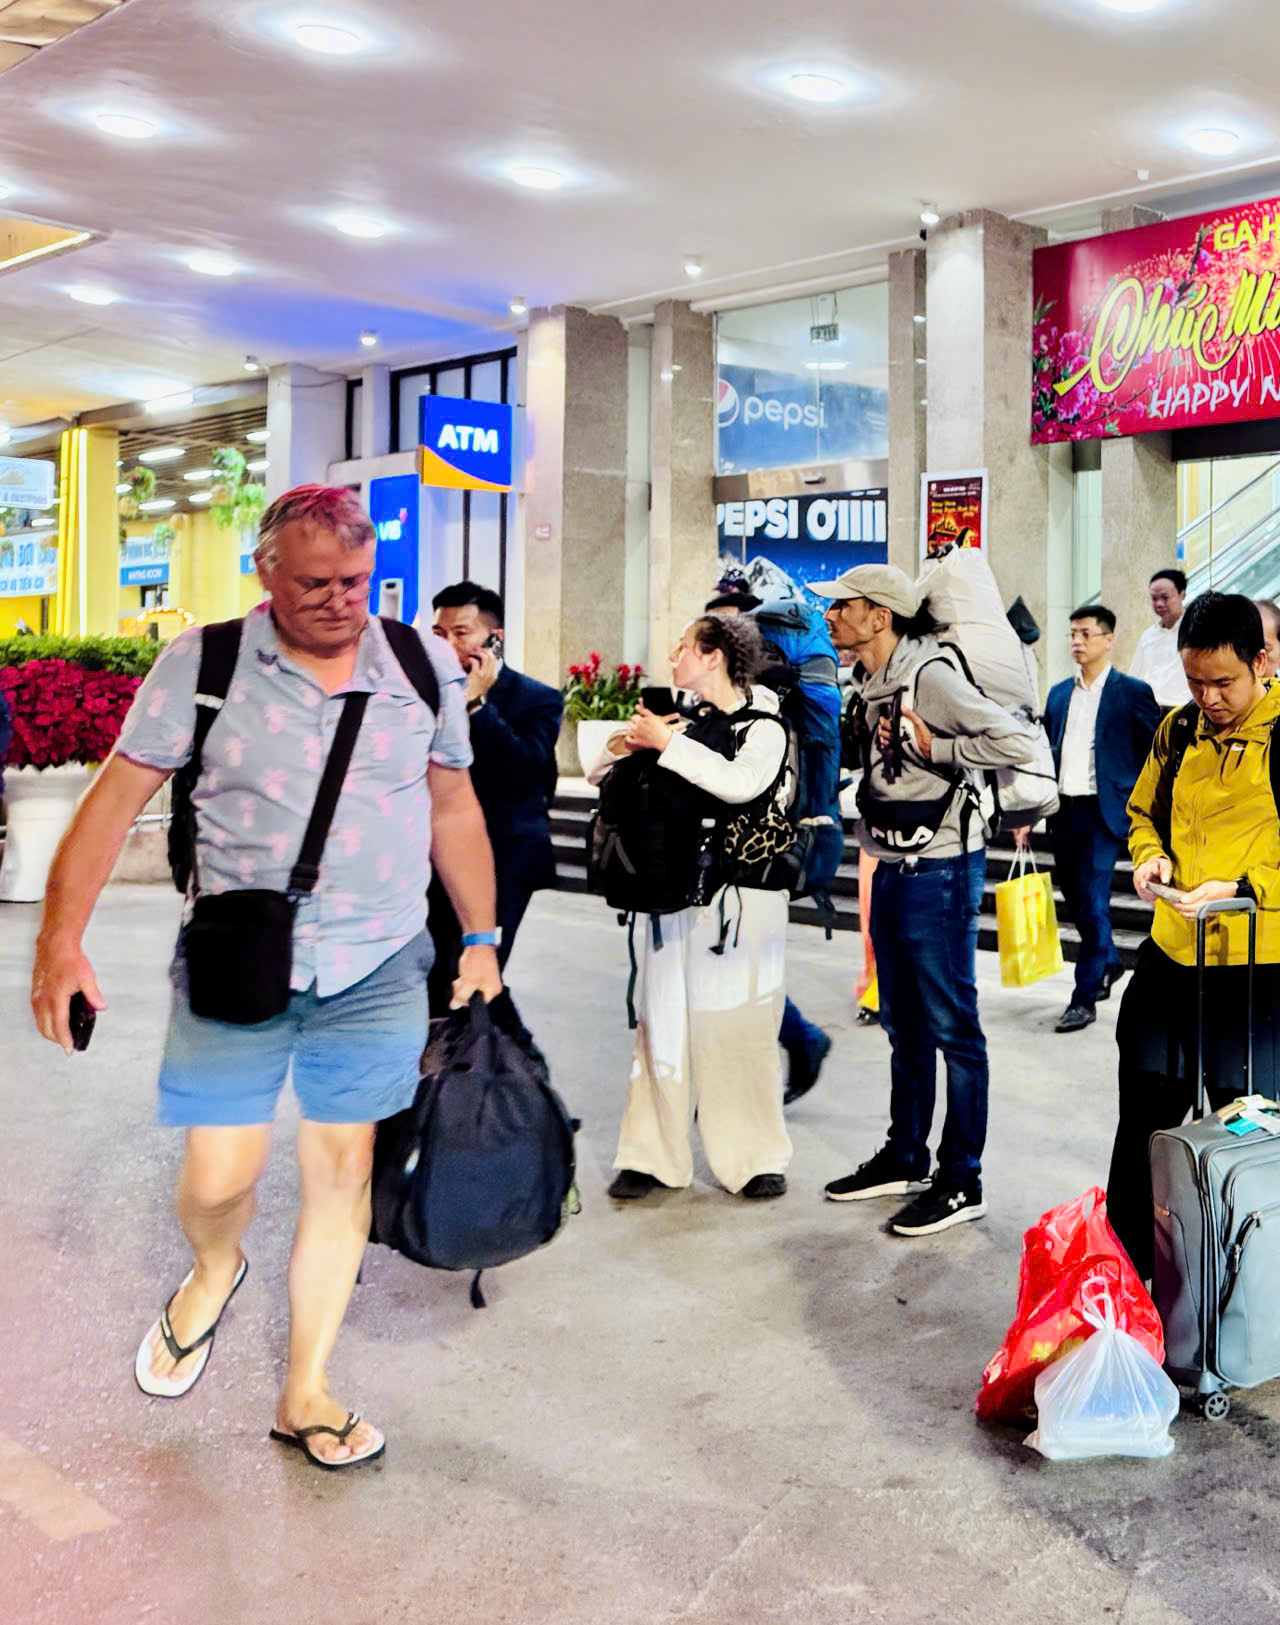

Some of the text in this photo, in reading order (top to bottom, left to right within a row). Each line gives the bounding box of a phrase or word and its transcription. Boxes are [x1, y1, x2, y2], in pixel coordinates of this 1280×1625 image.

[1213, 219, 1257, 251] GA
[1052, 277, 1241, 393] Chúc
[743, 396, 826, 430] pepsi
[1149, 377, 1251, 419] HAPPY
[437, 424, 499, 454] ATM
